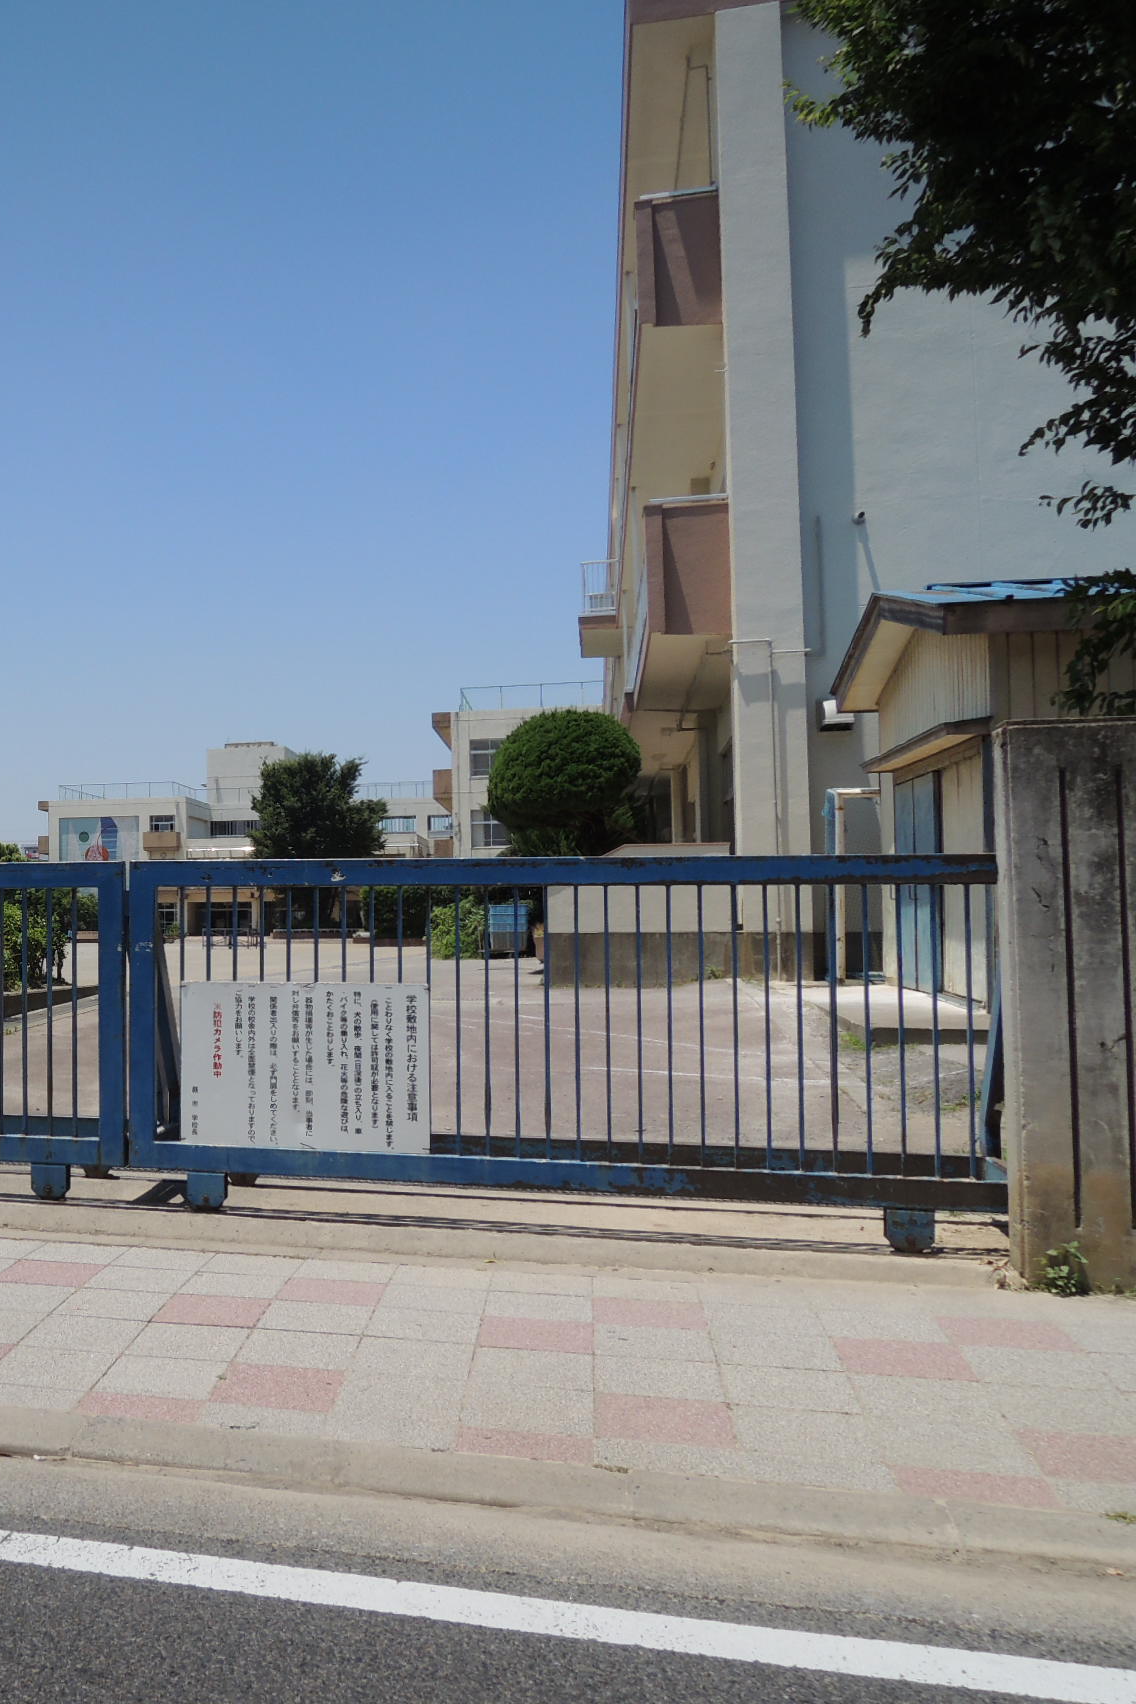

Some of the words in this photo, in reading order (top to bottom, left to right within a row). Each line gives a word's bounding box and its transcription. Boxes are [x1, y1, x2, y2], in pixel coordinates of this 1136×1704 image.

[406, 994, 418, 1122] 学校敷地内における注意事項
